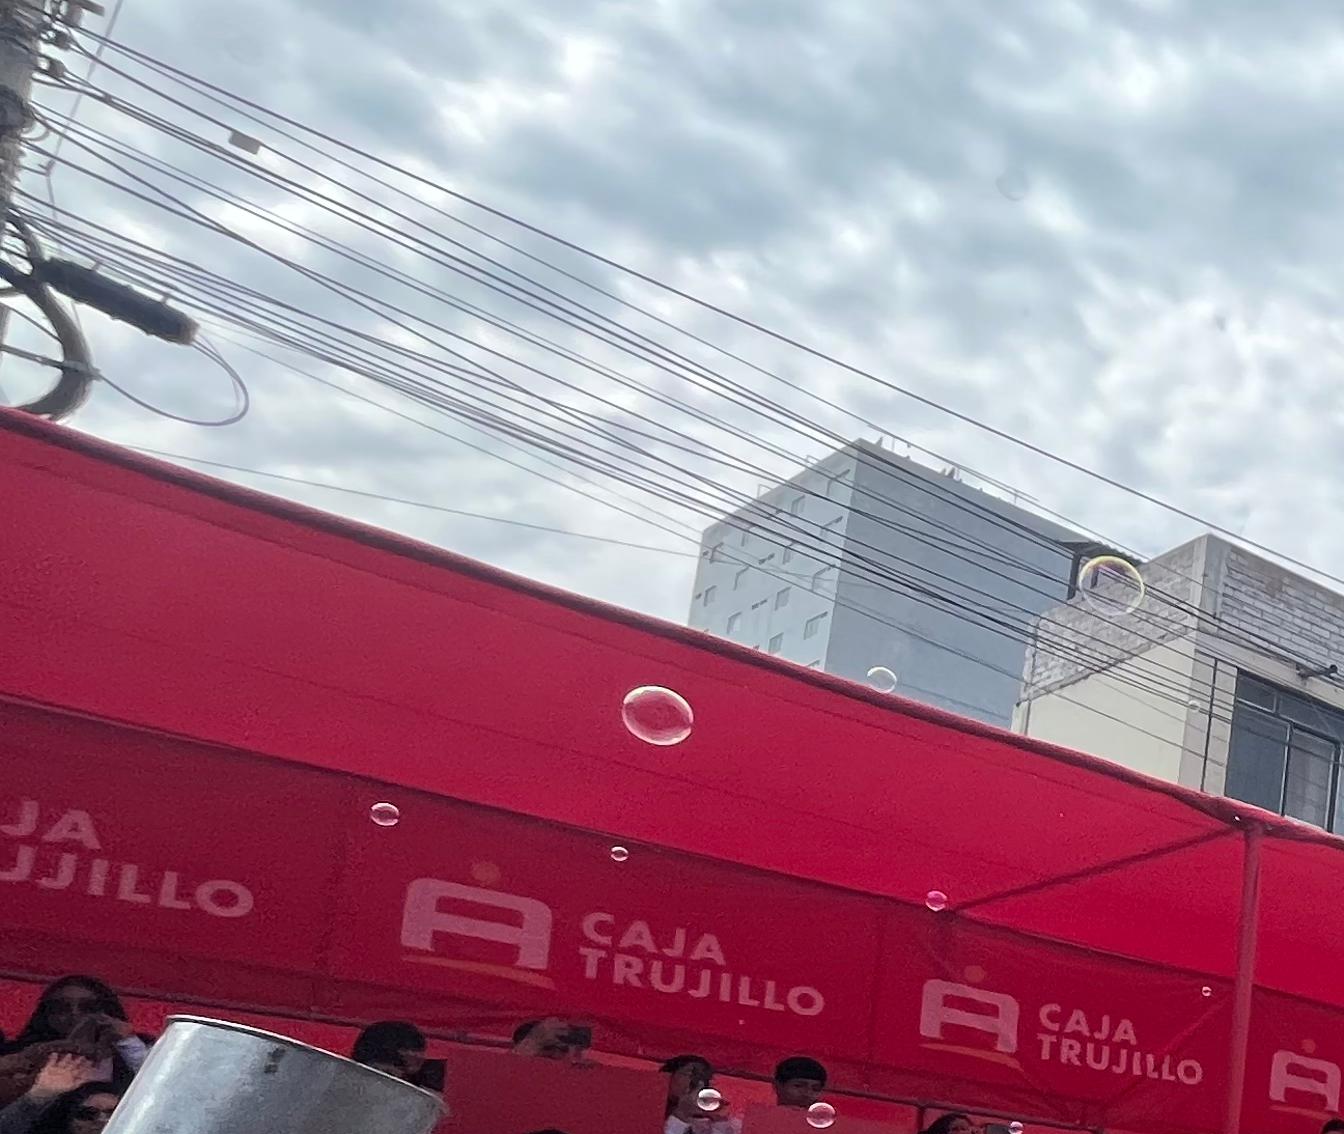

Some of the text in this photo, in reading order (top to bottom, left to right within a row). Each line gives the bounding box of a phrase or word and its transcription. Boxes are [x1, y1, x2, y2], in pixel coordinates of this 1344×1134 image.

[581, 911, 727, 967] CAJA
[579, 947, 826, 1017] TRUJILLO
[1038, 1002, 1137, 1046] CAJA
[1036, 1032, 1204, 1086] TRUJILLO
